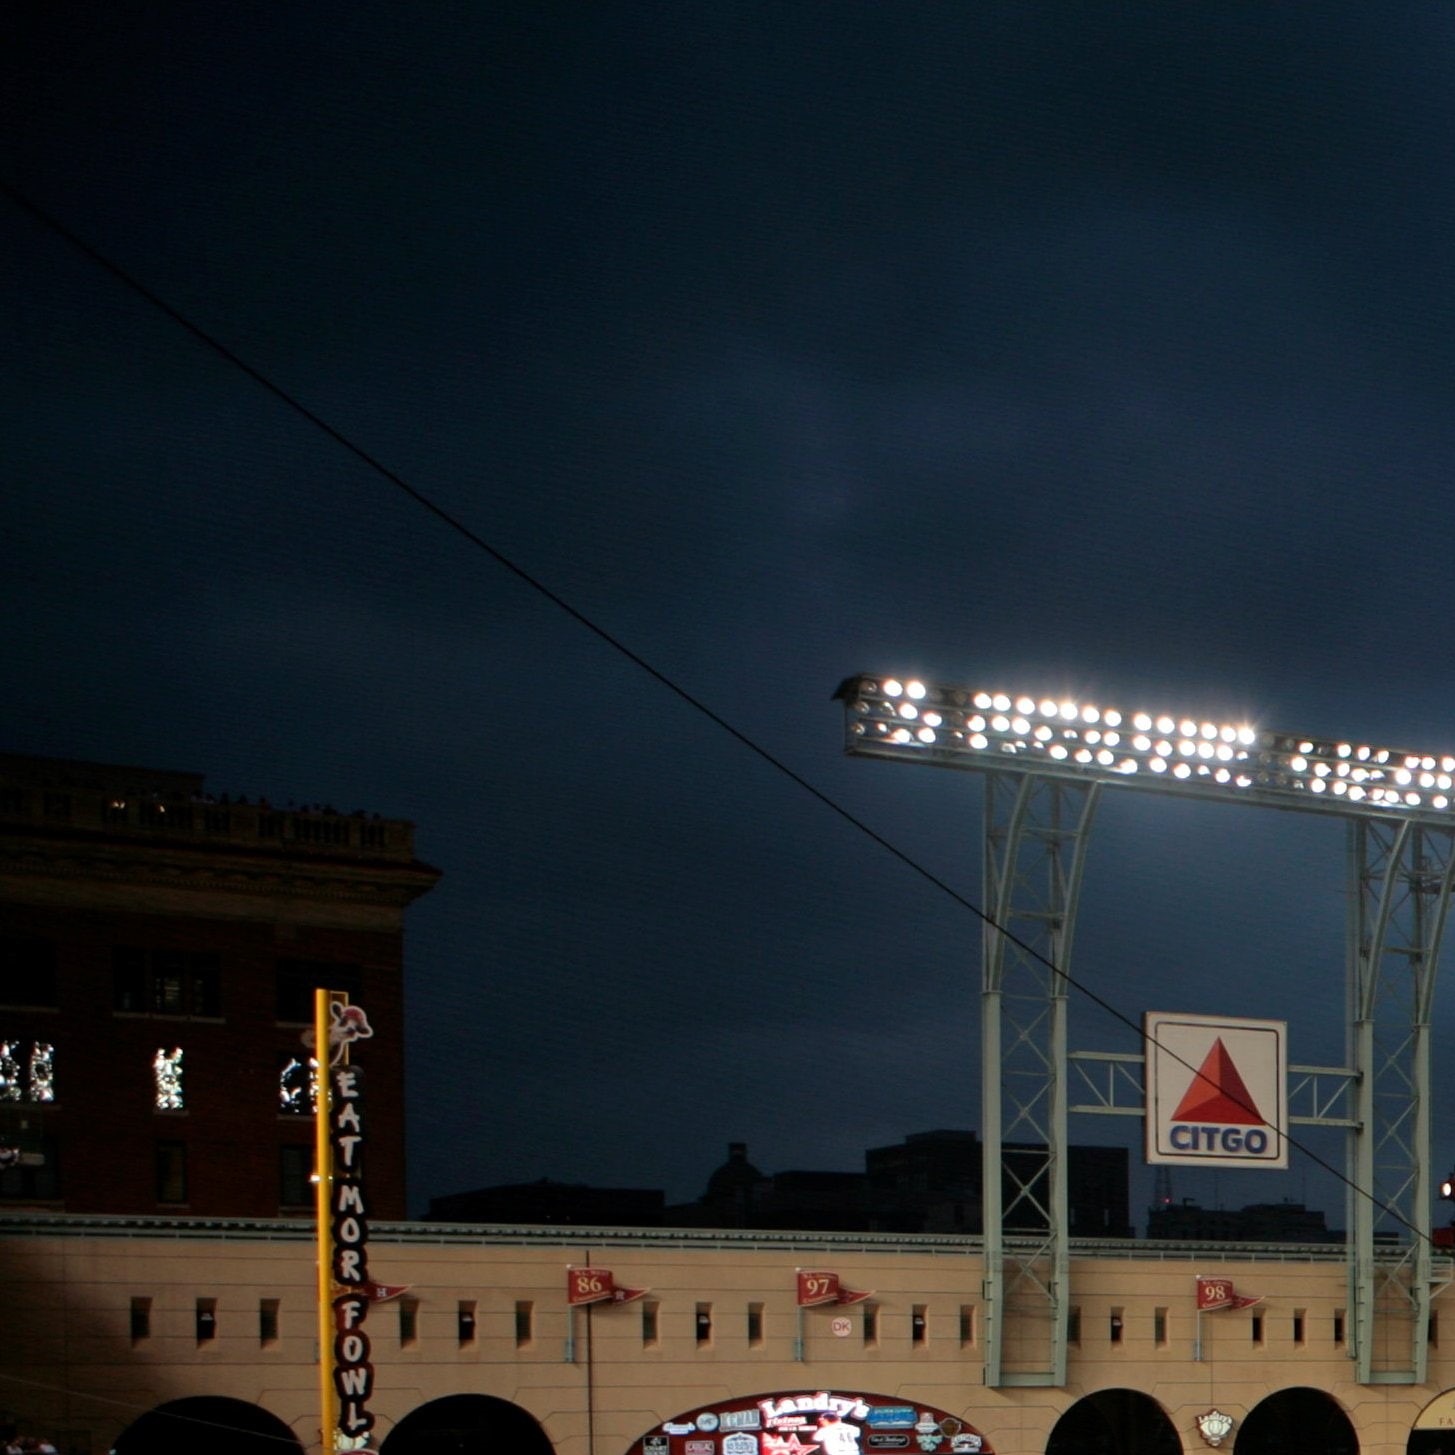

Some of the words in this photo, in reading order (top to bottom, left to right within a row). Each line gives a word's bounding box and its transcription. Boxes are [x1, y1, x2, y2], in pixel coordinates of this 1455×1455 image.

[1168, 1125, 1269, 1154] CITGO
[576, 1276, 603, 1293] 86
[805, 1278, 830, 1294] 97
[1204, 1285, 1226, 1301] 98
[831, 1320, 851, 1332] DK
[758, 1391, 870, 1420] Landry's
